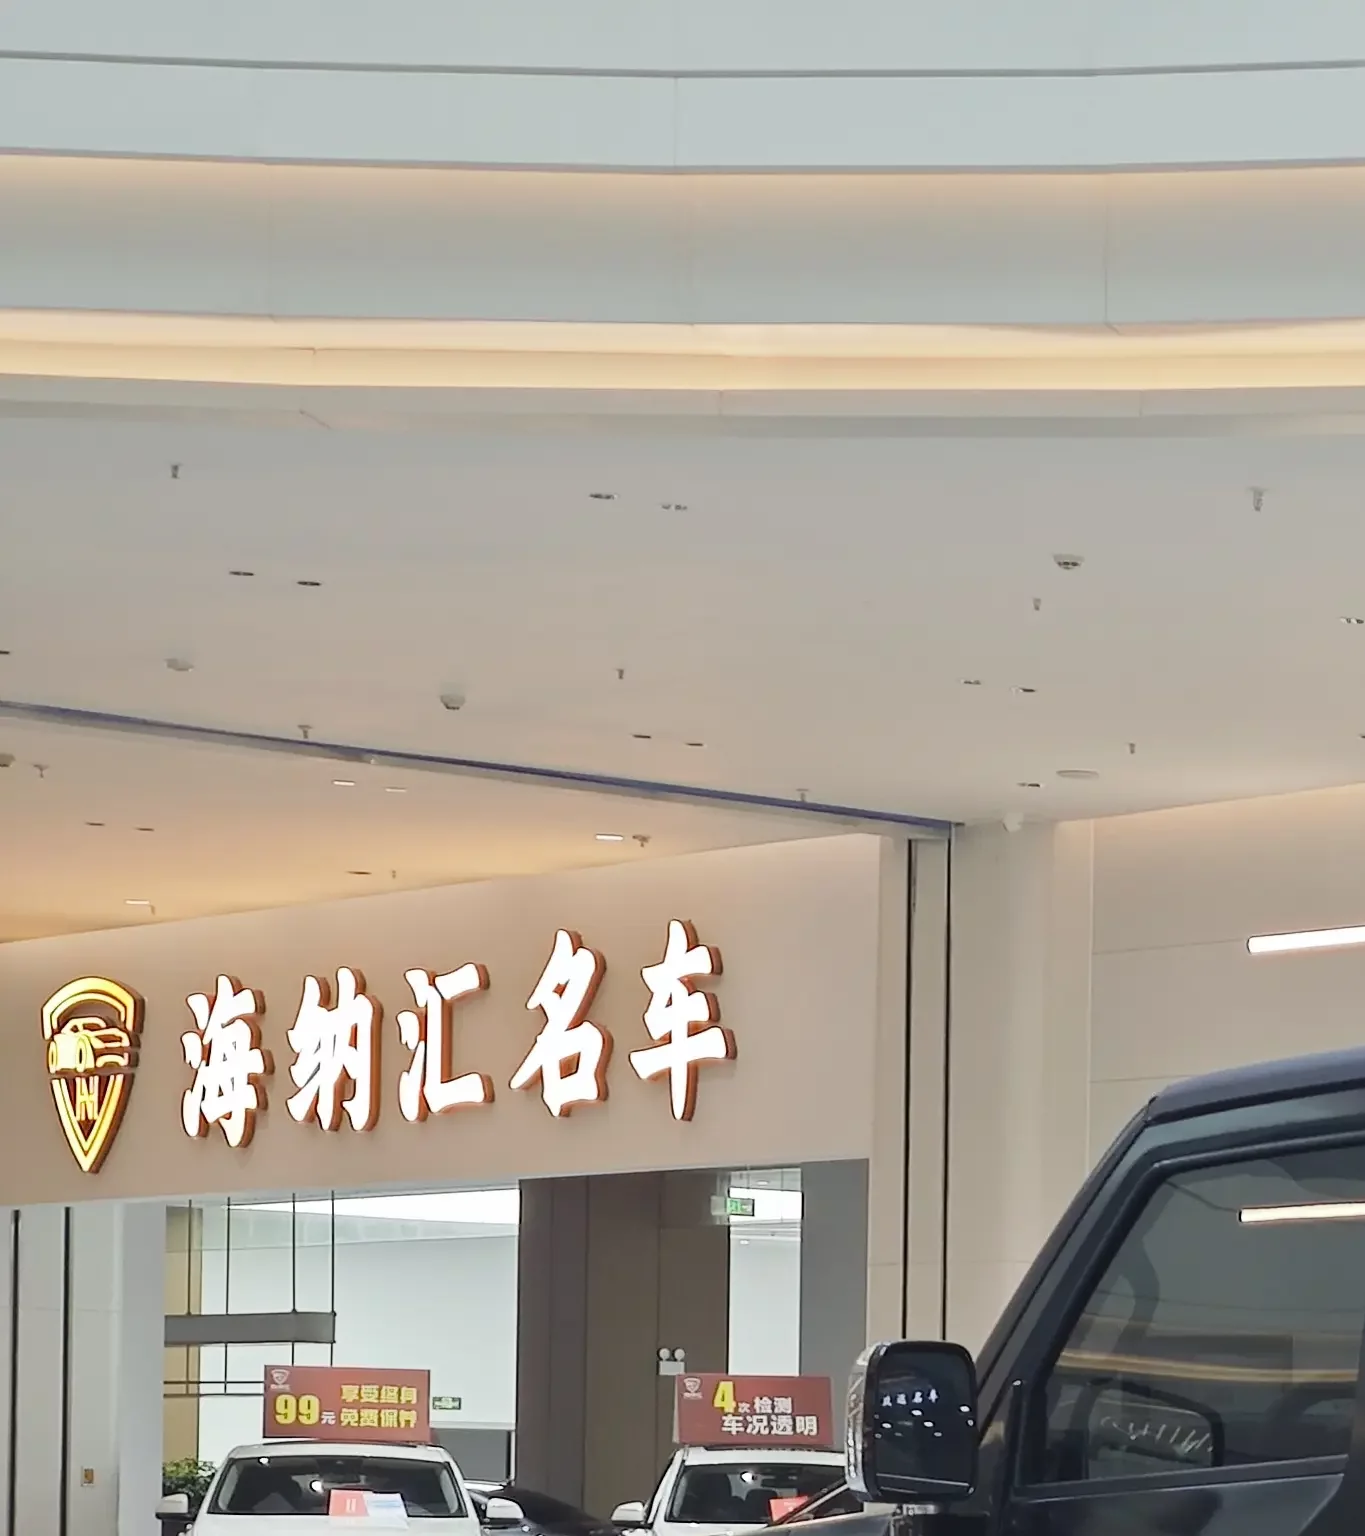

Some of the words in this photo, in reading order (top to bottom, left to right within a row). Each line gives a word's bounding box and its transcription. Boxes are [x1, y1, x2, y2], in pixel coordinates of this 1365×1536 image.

[180, 918, 737, 1148] 海纳汇名车
[721, 1413, 818, 1436] 车况透明
